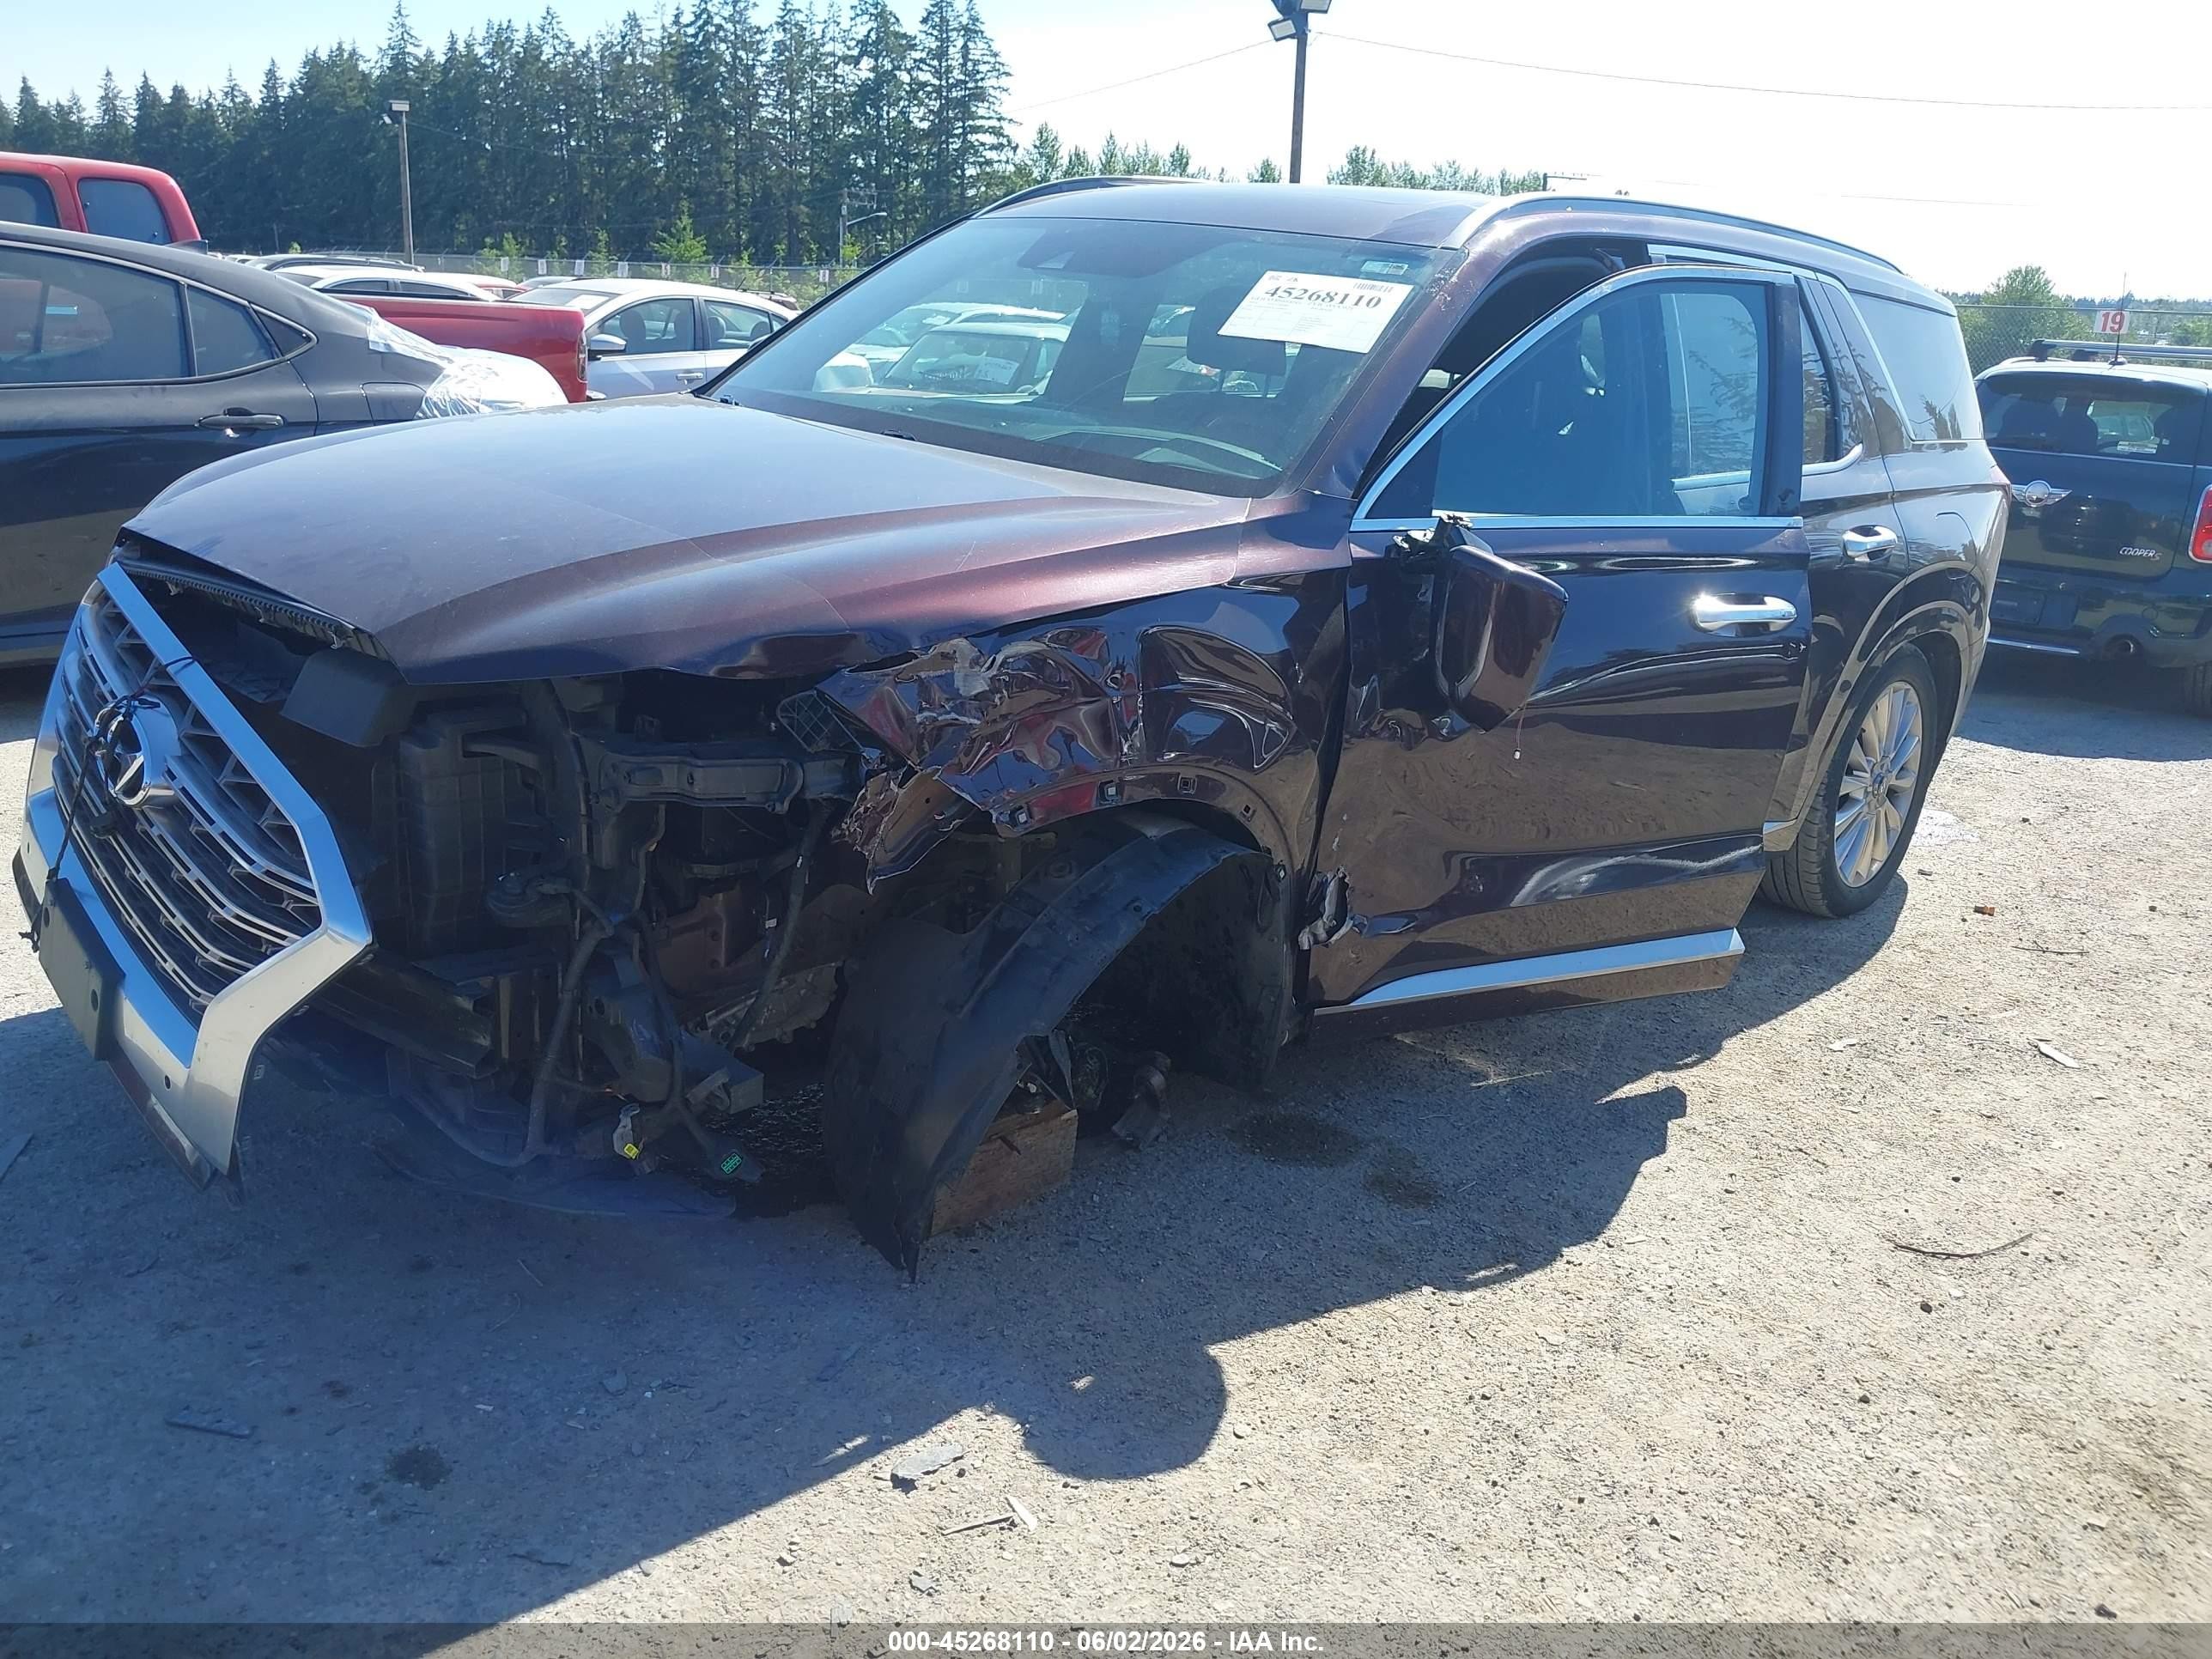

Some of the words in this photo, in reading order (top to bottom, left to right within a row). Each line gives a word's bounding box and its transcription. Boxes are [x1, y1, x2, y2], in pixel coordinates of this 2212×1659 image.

[1264, 285, 1382, 309] 45268110
[2101, 311, 2125, 333] 19
[2119, 547, 2156, 557] COOPER
